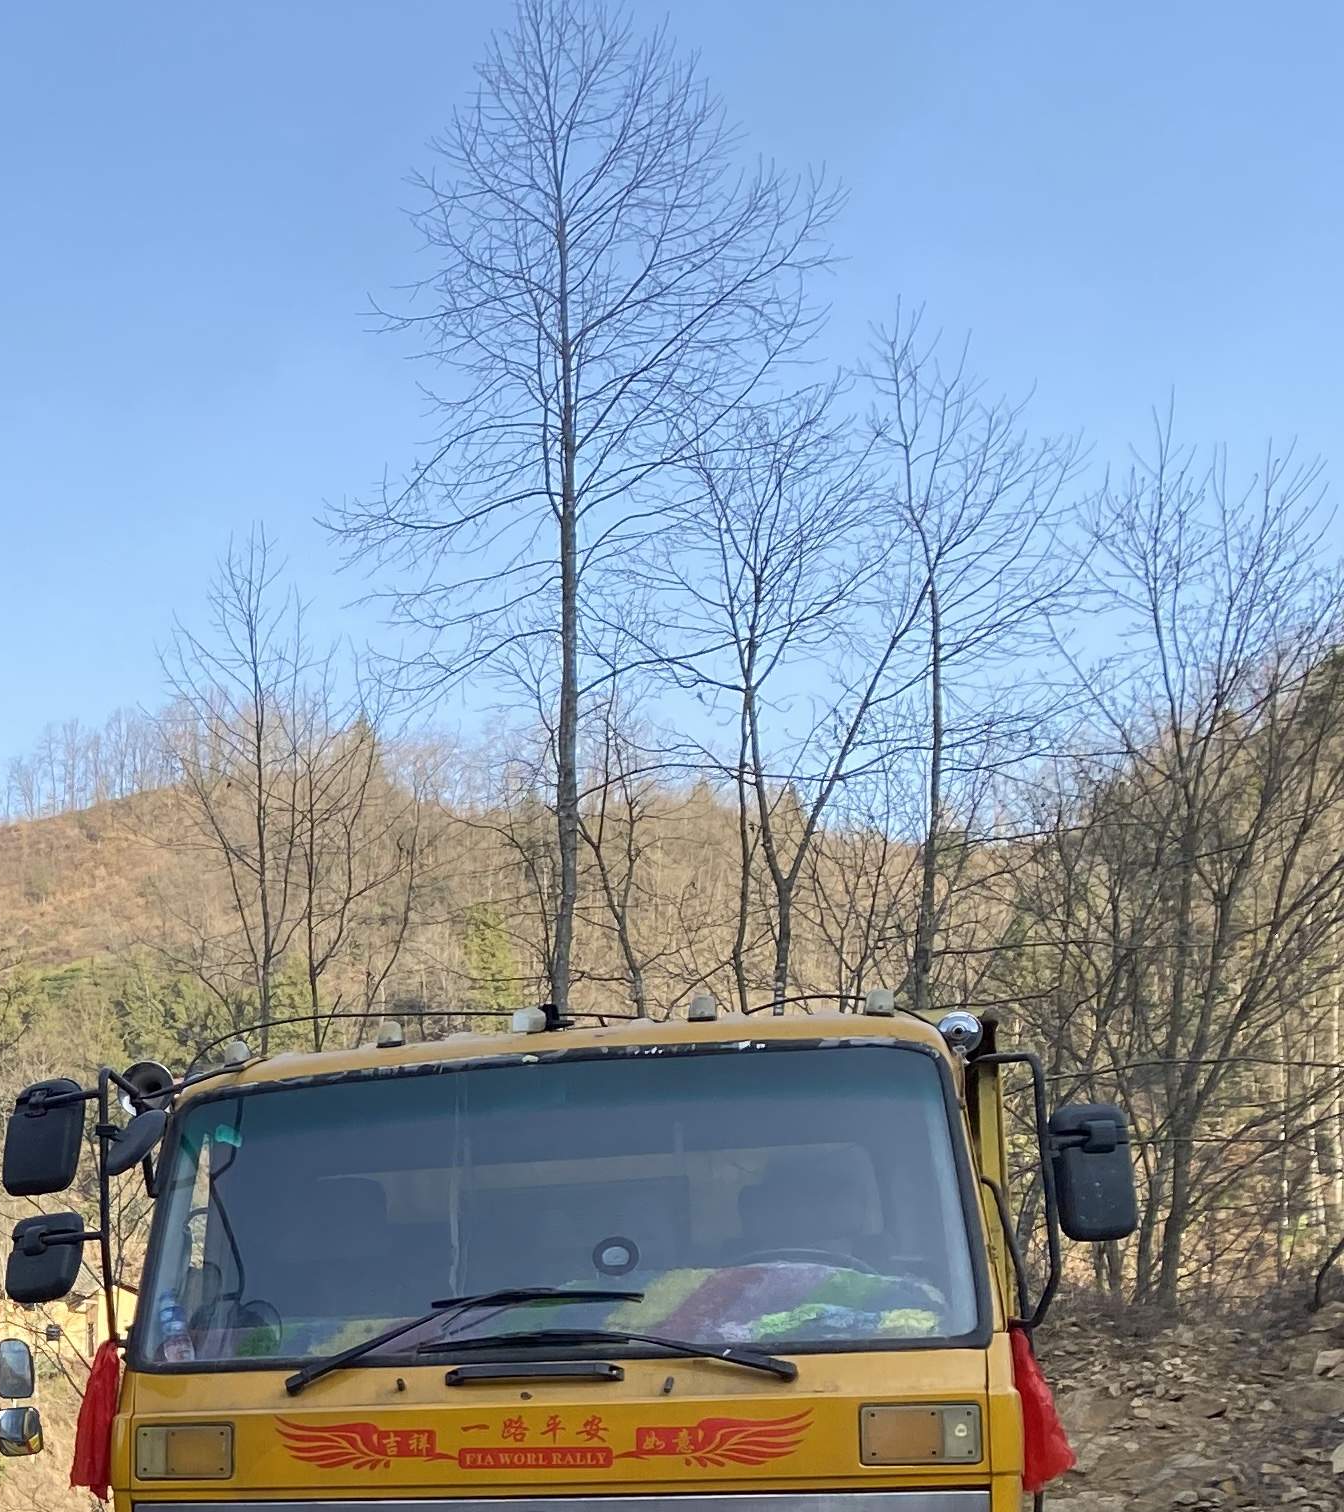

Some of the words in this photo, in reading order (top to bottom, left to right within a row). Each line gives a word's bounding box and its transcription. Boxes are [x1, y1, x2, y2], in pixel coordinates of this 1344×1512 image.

[460, 1414, 610, 1444] 一路平安
[642, 1429, 695, 1453] 如意
[382, 1432, 431, 1456] 吉祥
[465, 1453, 495, 1466] FIA
[499, 1452, 548, 1466] WORL
[552, 1451, 608, 1466] RALLY
